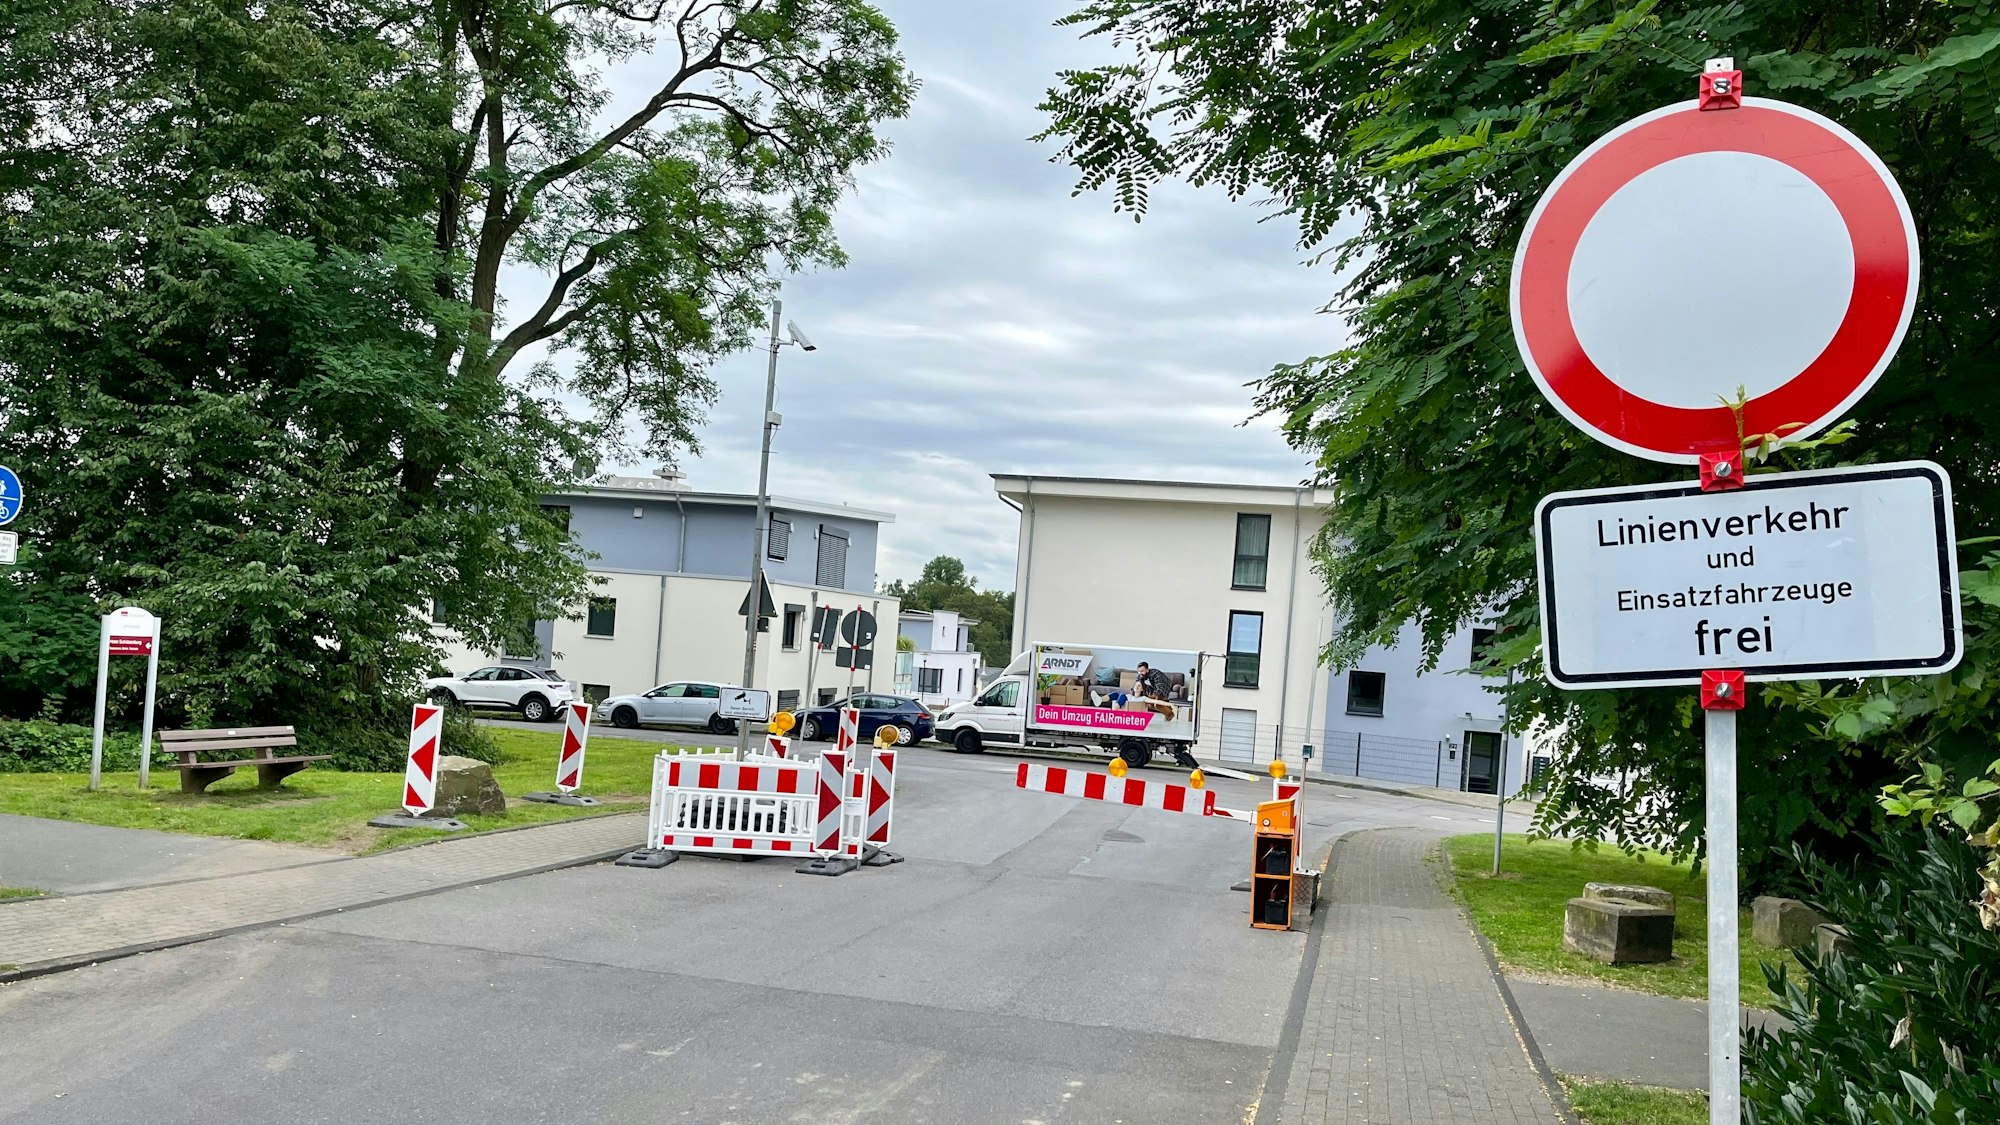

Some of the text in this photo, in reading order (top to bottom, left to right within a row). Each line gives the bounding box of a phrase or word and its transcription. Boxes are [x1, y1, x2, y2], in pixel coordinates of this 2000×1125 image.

[1597, 501, 1849, 547] Linienverkehr
[1706, 546, 1754, 569] und
[1617, 581, 1852, 611] Einsatzfahrzeuge
[1694, 616, 1773, 656] frei
[1041, 658, 1081, 669] ARNDT
[1039, 708, 1145, 726] Dein Umzug FAIRmieten
